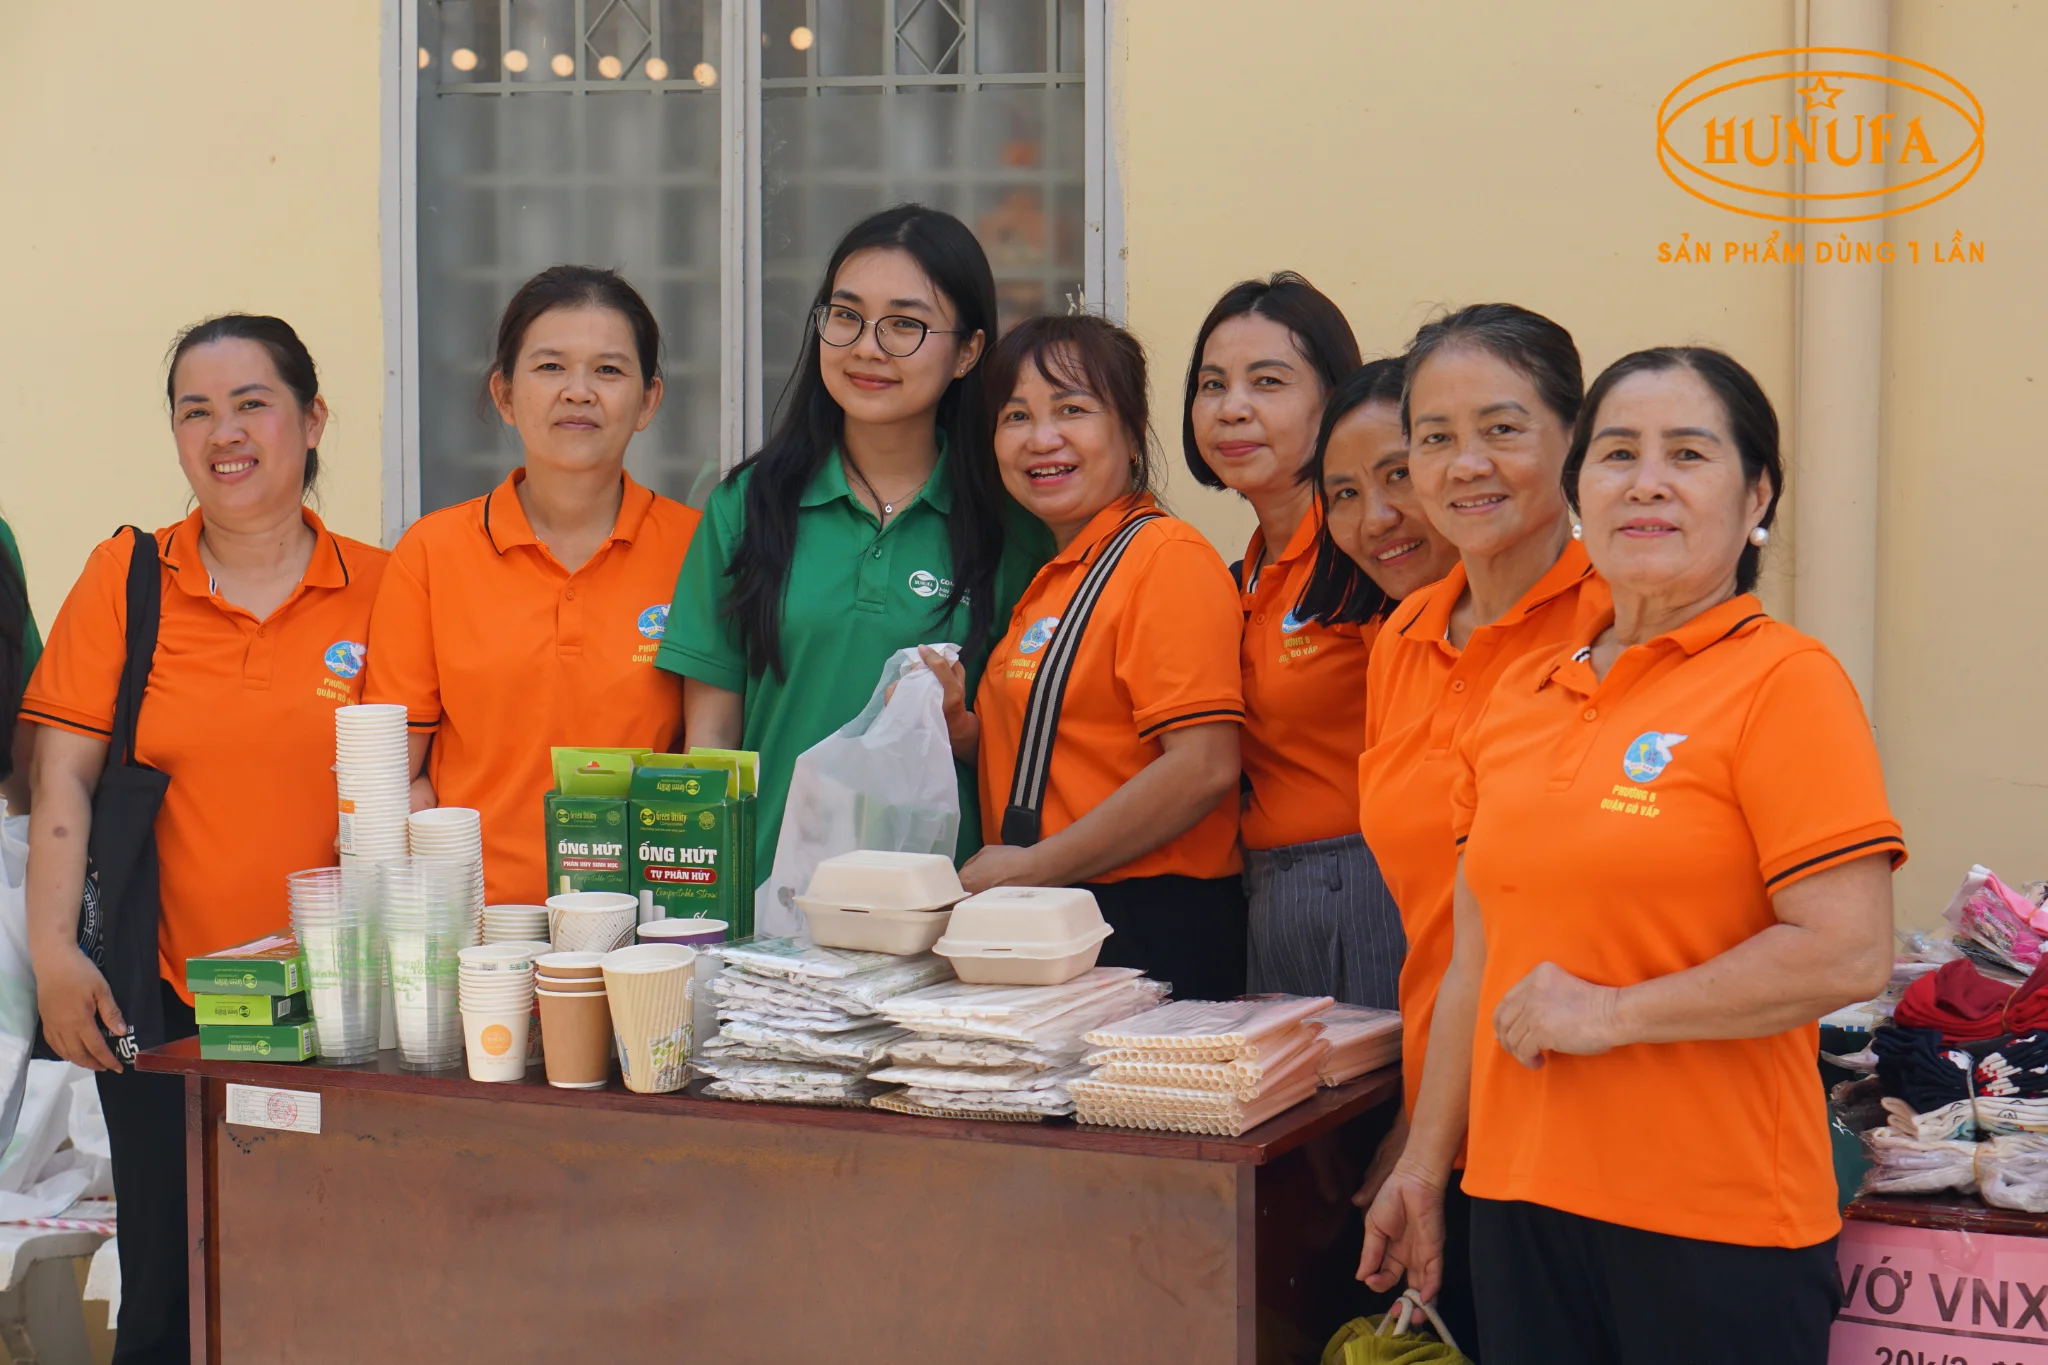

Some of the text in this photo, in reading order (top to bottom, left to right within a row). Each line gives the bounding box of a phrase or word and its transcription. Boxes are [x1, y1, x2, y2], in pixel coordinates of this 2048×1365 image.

[317, 688, 336, 699] QUẬN
[1612, 785, 1656, 802] PHƯỜNG 6
[1600, 798, 1660, 817] QUẬN GÒ VẤP
[558, 838, 623, 856] ỐNG HÚT
[638, 841, 718, 865] ỐNG HÚT
[563, 859, 579, 868] PHÂN
[592, 861, 607, 869] SINH
[606, 861, 619, 870] HỌC
[650, 869, 711, 881] TỰ PHÂN HỦY
